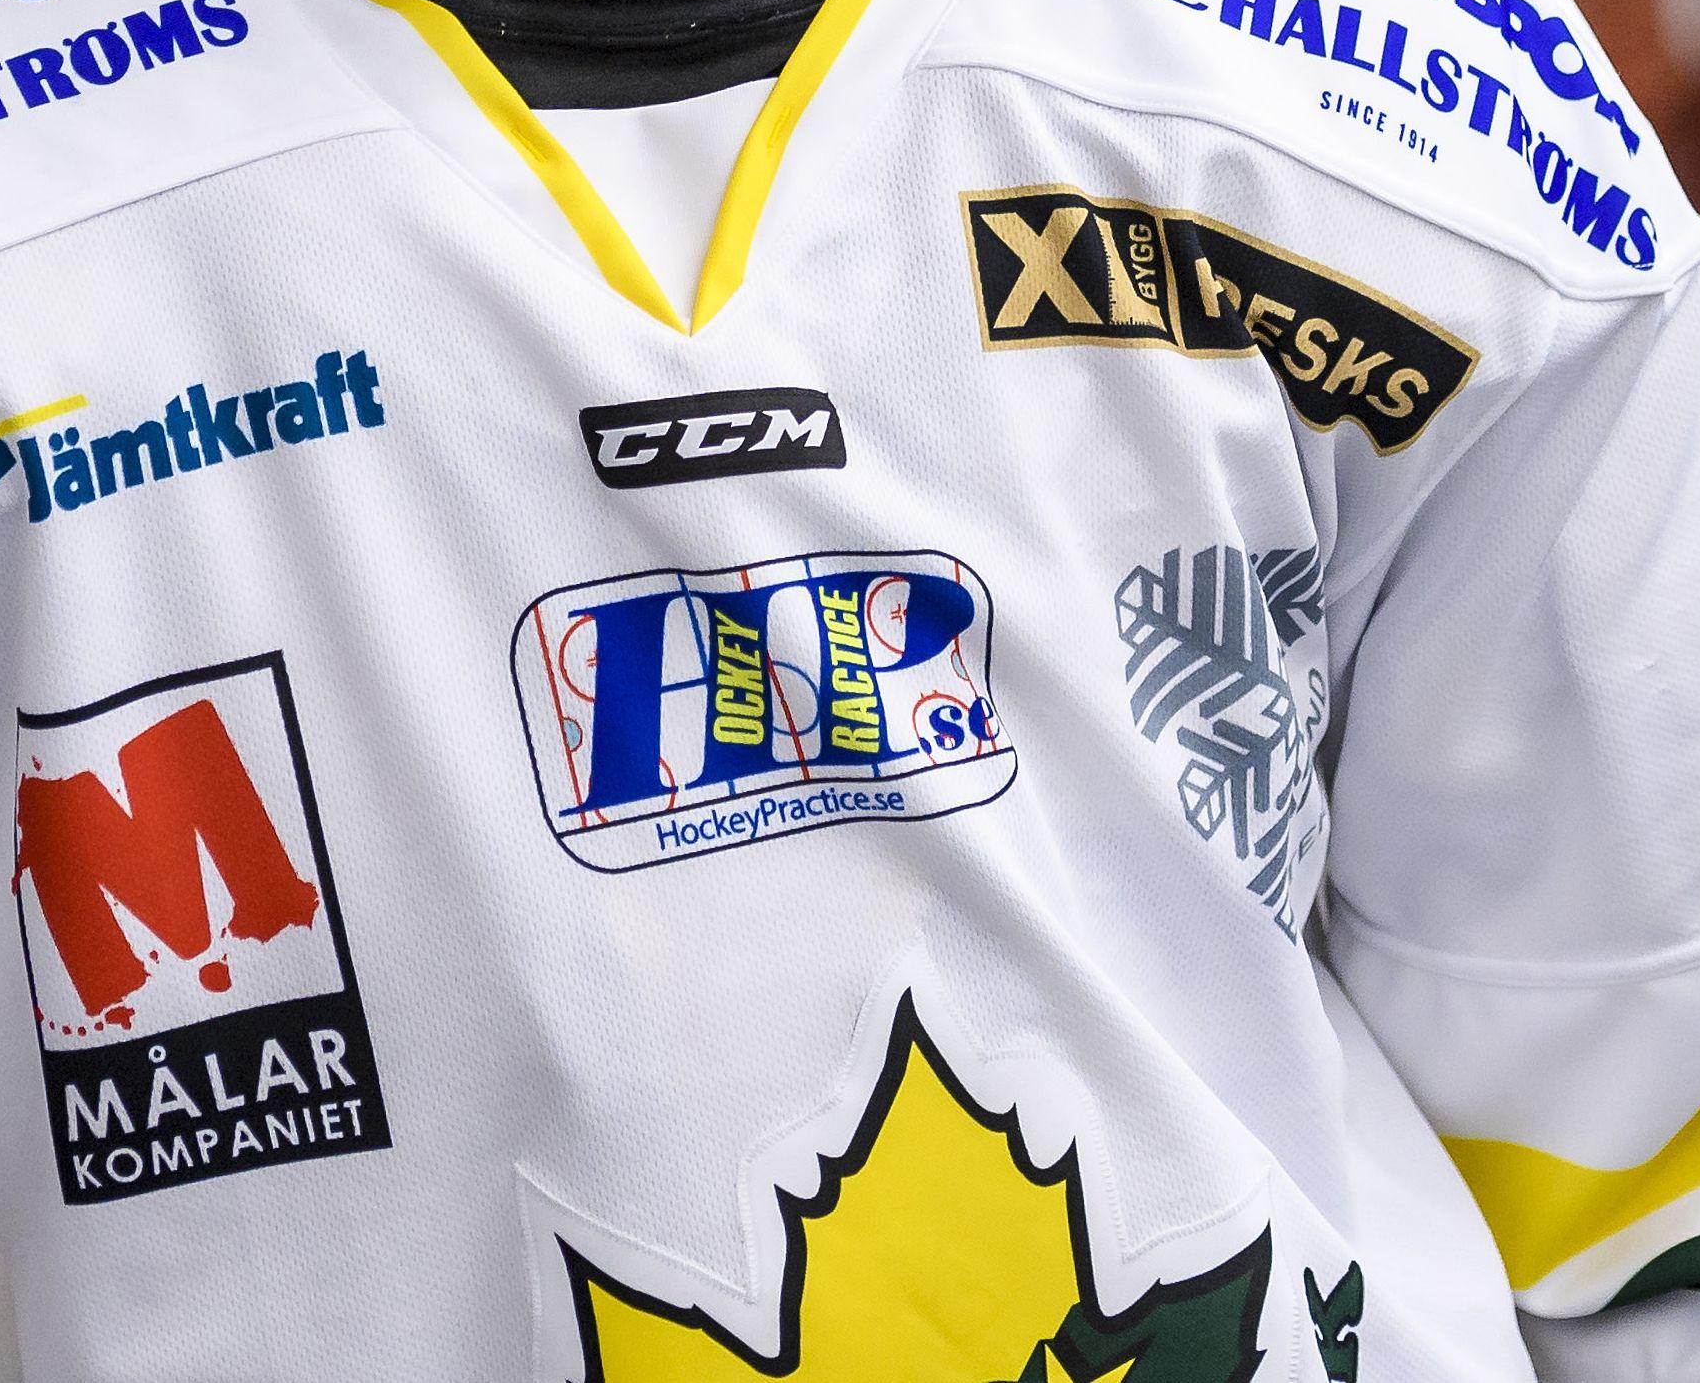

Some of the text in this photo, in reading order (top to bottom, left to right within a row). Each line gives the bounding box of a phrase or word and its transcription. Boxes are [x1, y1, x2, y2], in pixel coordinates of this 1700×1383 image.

[1320, 89, 1440, 164] SINCE 1914
[1128, 222, 1158, 300] BYGG
[14, 348, 387, 525] Jämtkraft
[593, 404, 835, 470] CCM
[713, 608, 765, 746] OCKEY
[818, 585, 882, 755] RACTICE
[656, 789, 905, 852] HockeyPractice.se
[64, 1028, 357, 1143] MÅLAR
[72, 1099, 363, 1191] KOMPANIET
